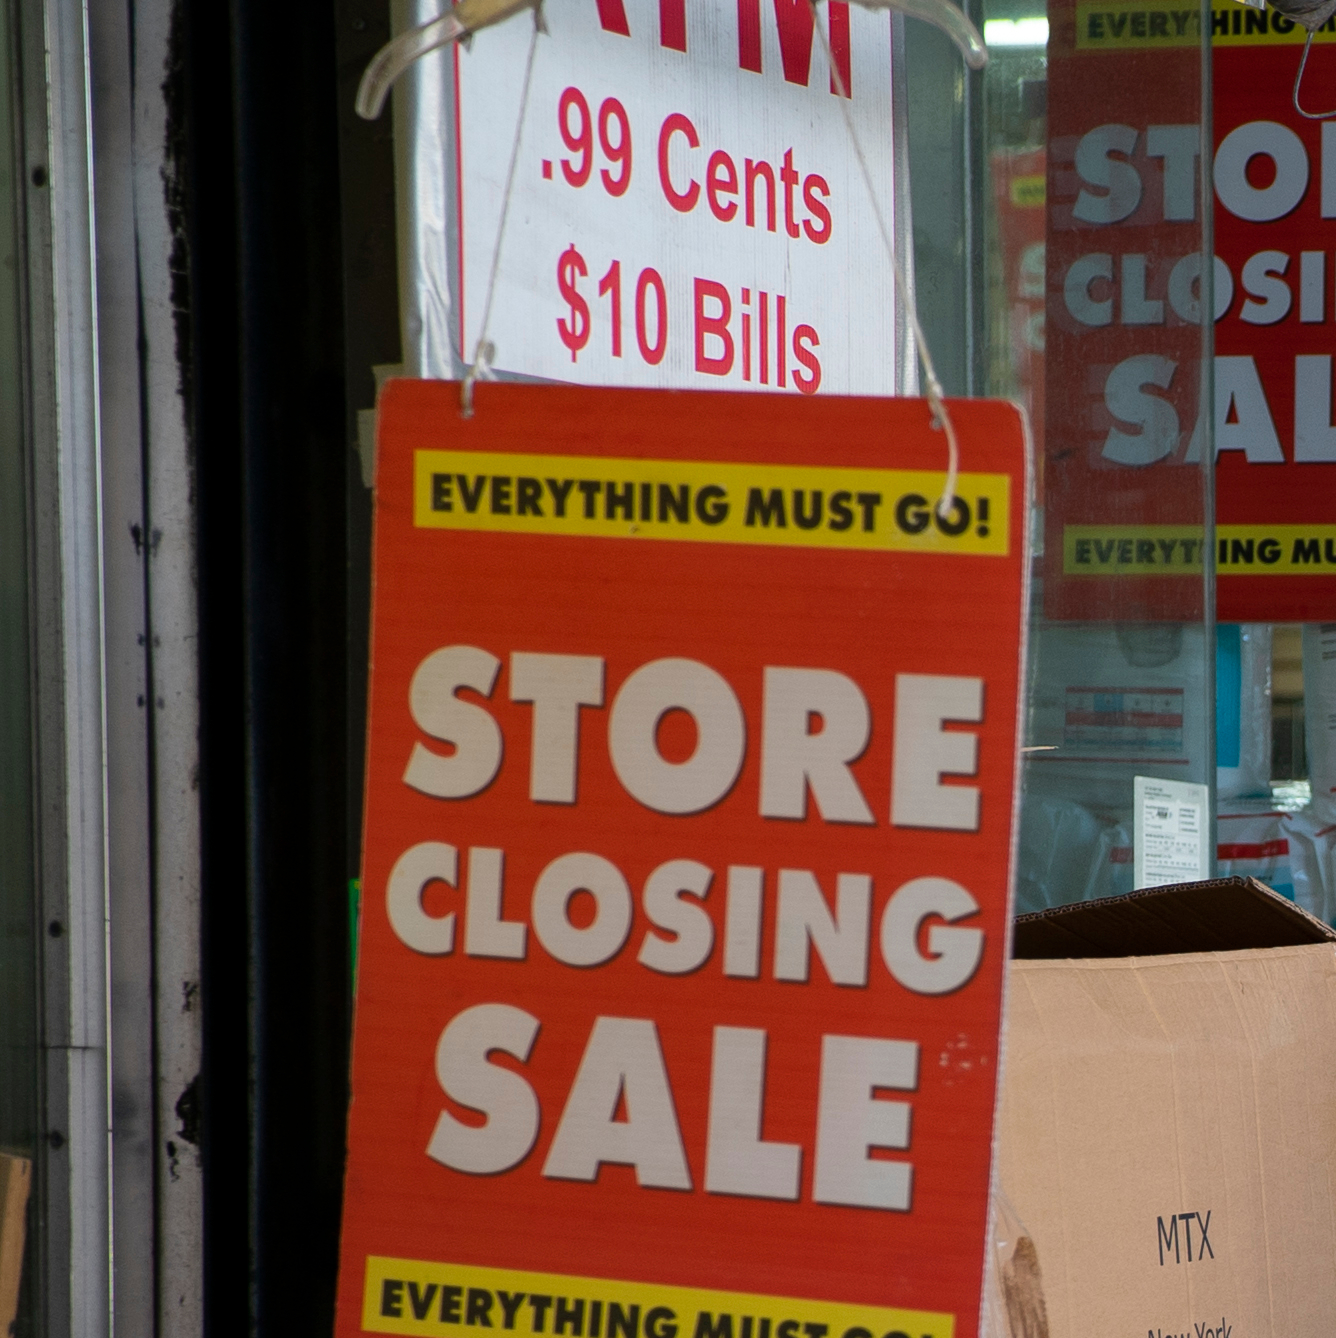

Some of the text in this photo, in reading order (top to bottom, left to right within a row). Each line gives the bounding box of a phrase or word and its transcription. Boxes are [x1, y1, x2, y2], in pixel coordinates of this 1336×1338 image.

[542, 86, 833, 245] .99 Cents
[556, 243, 822, 396] $10 Bills
[430, 472, 990, 538] EVERYTHING MUST GO!
[401, 645, 985, 832] STORE
[385, 841, 986, 995] CLOSING
[424, 1003, 920, 1211] SALE
[1157, 1210, 1214, 1266] MTX
